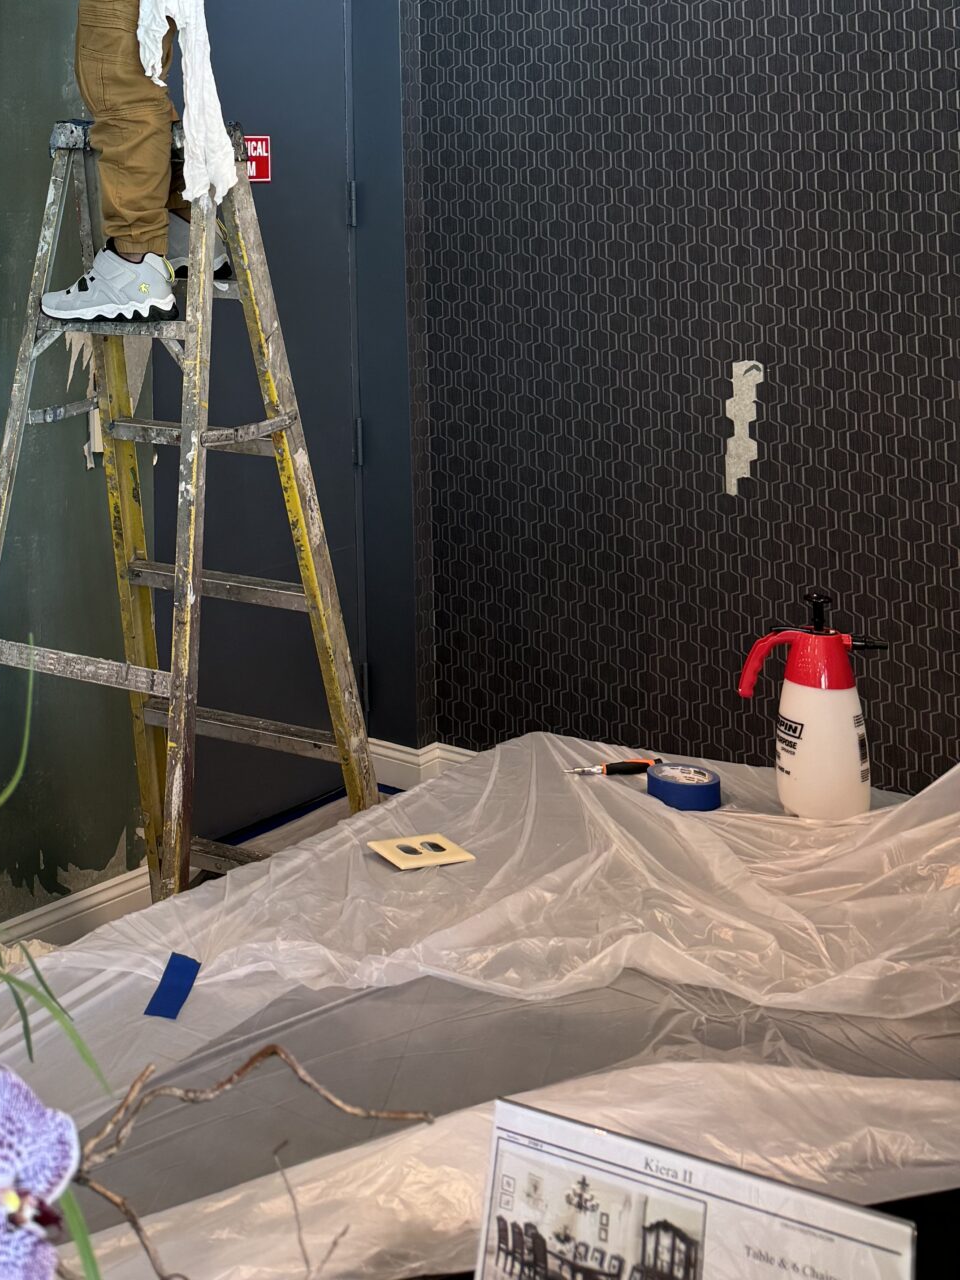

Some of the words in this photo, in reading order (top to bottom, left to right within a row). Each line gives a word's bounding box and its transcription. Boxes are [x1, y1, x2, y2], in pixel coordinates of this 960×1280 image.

[246, 140, 269, 156] ICAL
[644, 1156, 679, 1180] Kiera
[744, 1244, 775, 1266] Table
[778, 1258, 788, 1271] &
[802, 1265, 841, 1280] Chair
